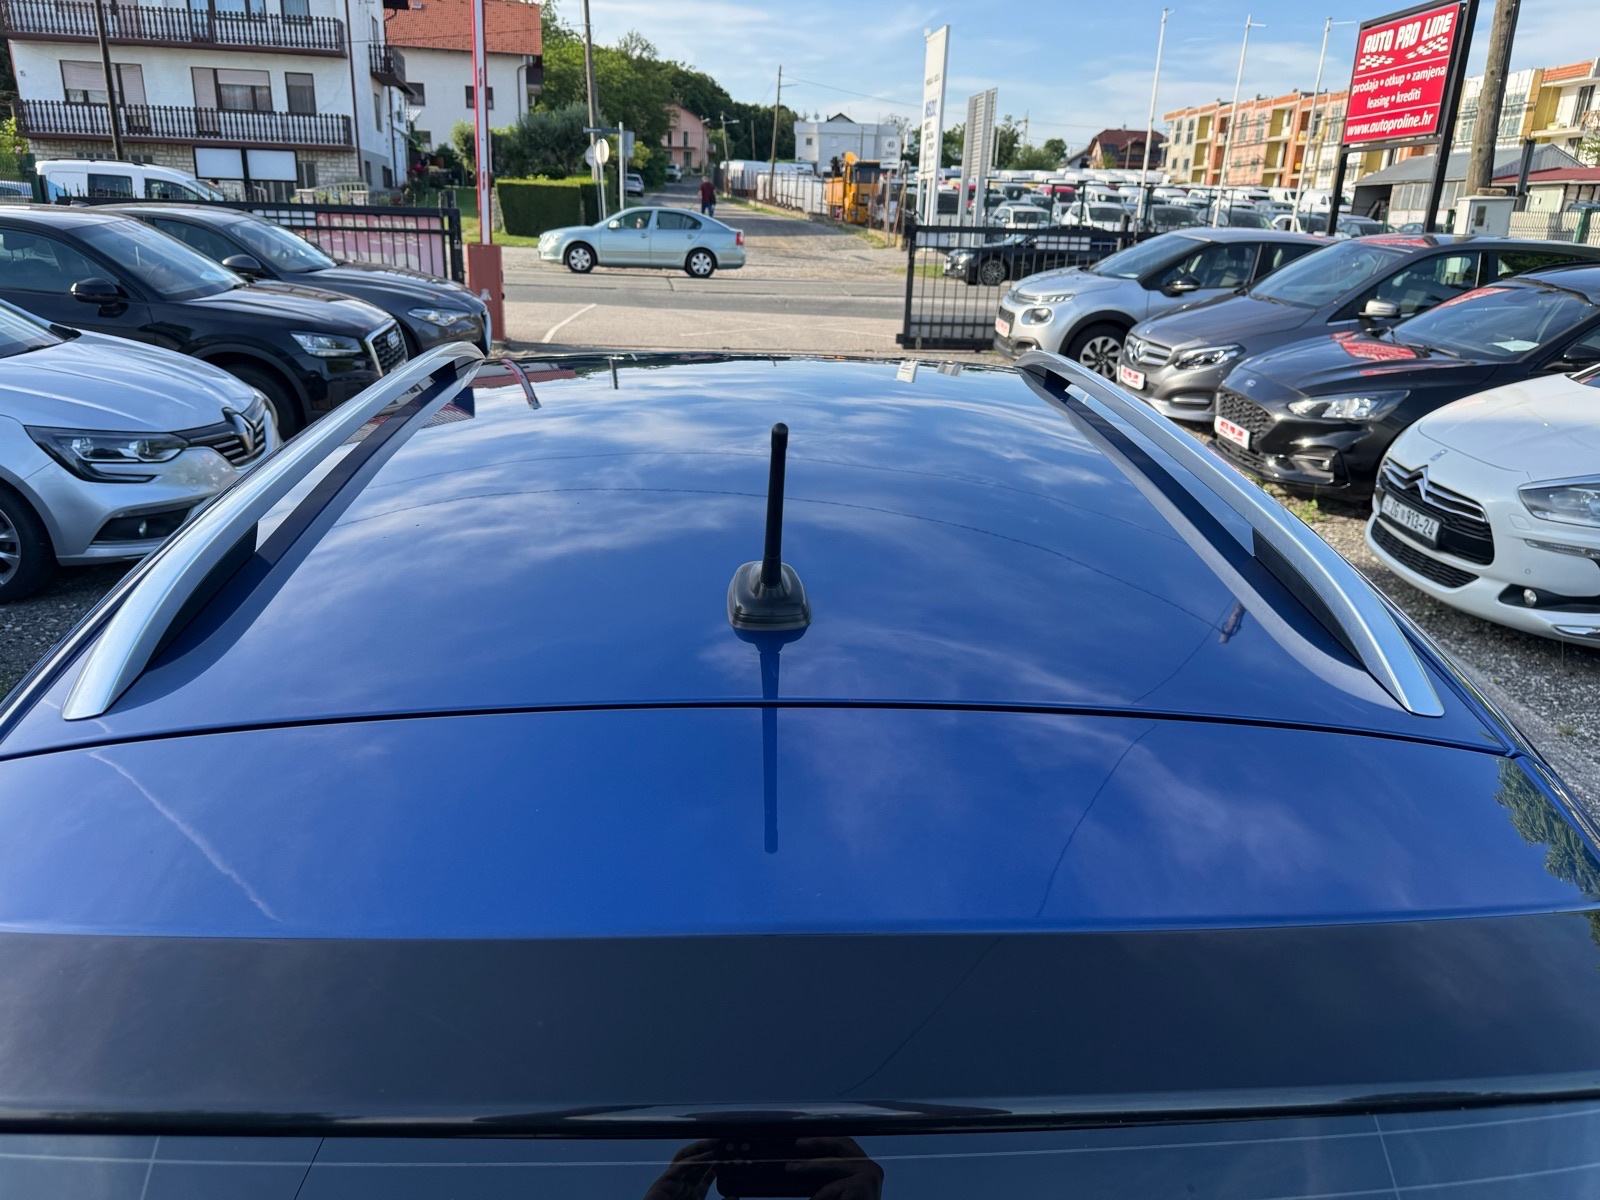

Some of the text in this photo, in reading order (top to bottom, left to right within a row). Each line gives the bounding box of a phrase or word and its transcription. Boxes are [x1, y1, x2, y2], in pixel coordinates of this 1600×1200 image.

[1362, 12, 1454, 54] AUTO PRO LINE
[1352, 66, 1446, 96] prodaja otkup zamjena
[1366, 87, 1421, 109] leasing krediti
[1346, 110, 1434, 136] www.autoproline.hr
